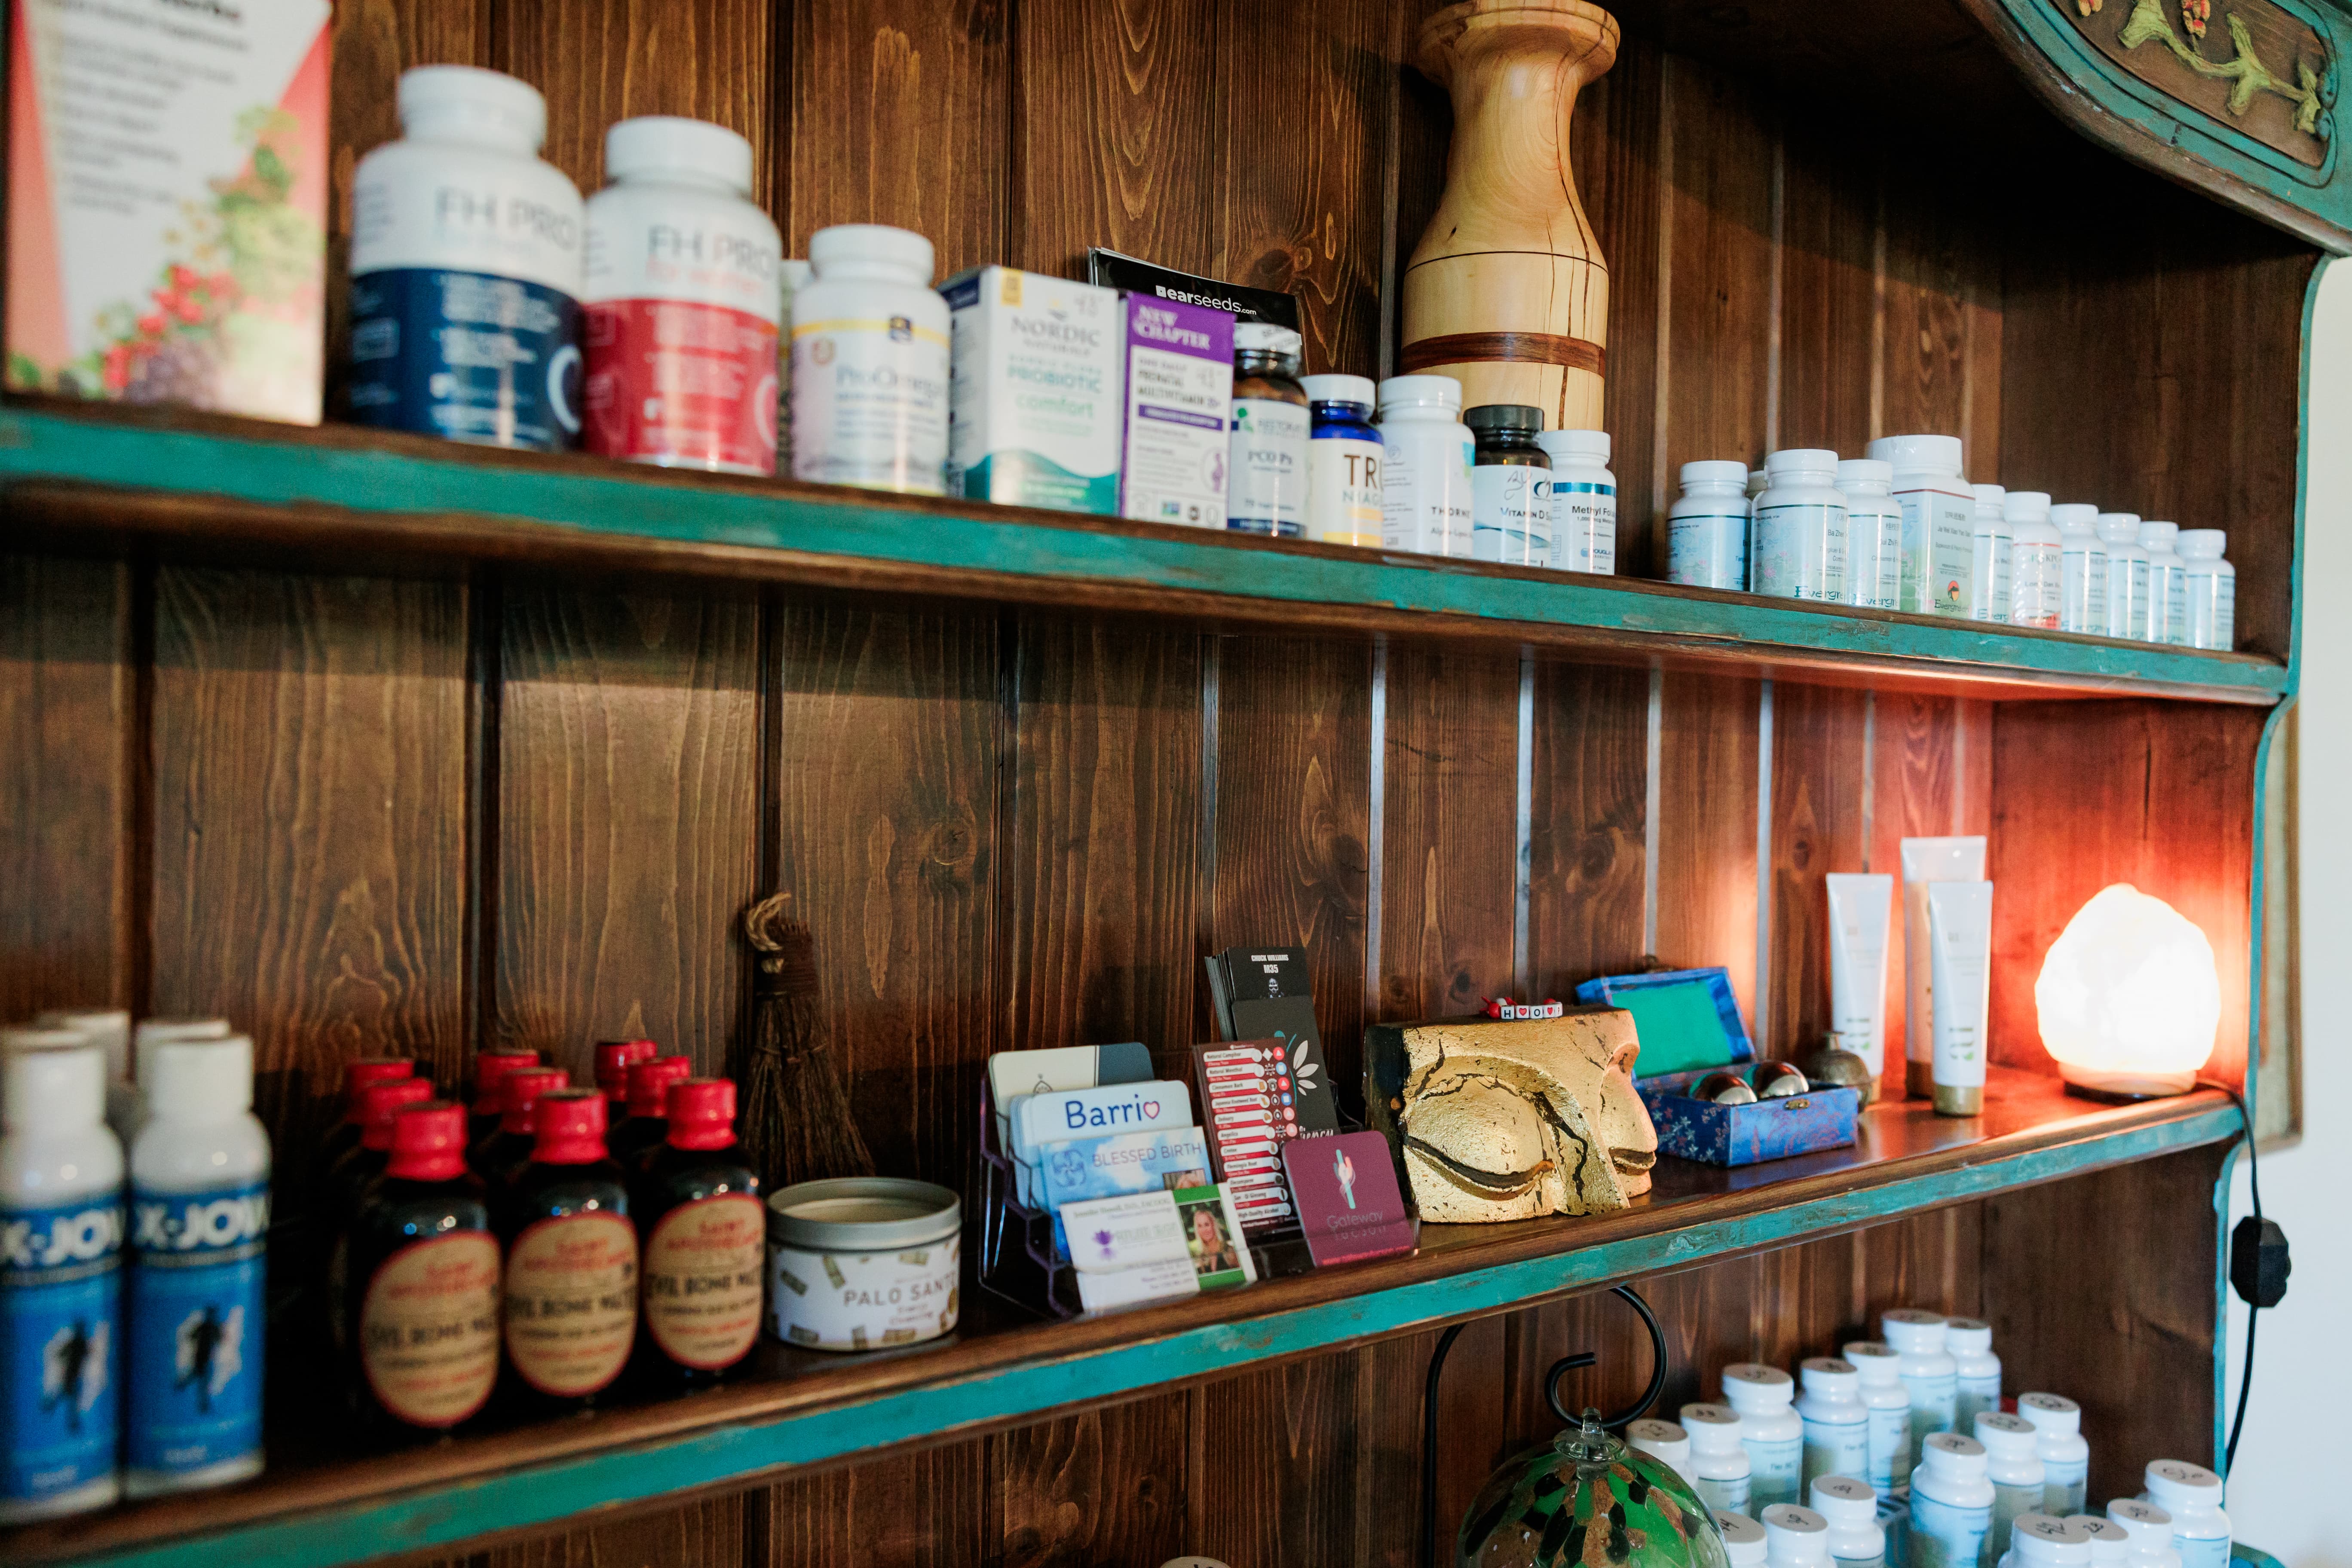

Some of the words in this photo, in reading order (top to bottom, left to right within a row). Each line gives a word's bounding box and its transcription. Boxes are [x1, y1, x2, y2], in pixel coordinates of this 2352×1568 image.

[436, 188, 495, 226] FH
[508, 200, 578, 250] PRO
[650, 225, 701, 255] FH
[1167, 288, 1257, 315] earseeds.com
[1139, 305, 1178, 327] NEW
[1011, 315, 1101, 347] NORDIC
[1132, 319, 1210, 350] CHAPTER
[1007, 364, 1102, 394] PROBIOTIC
[1017, 393, 1094, 420] comfort
[1934, 599, 1969, 612] Evergreen
[1263, 964, 1279, 974] M35
[1093, 1147, 1157, 1167] BLESSED
[1161, 1142, 1202, 1159] BIRTH
[1326, 1211, 1383, 1232] Gateway
[844, 1287, 902, 1308] PALO
